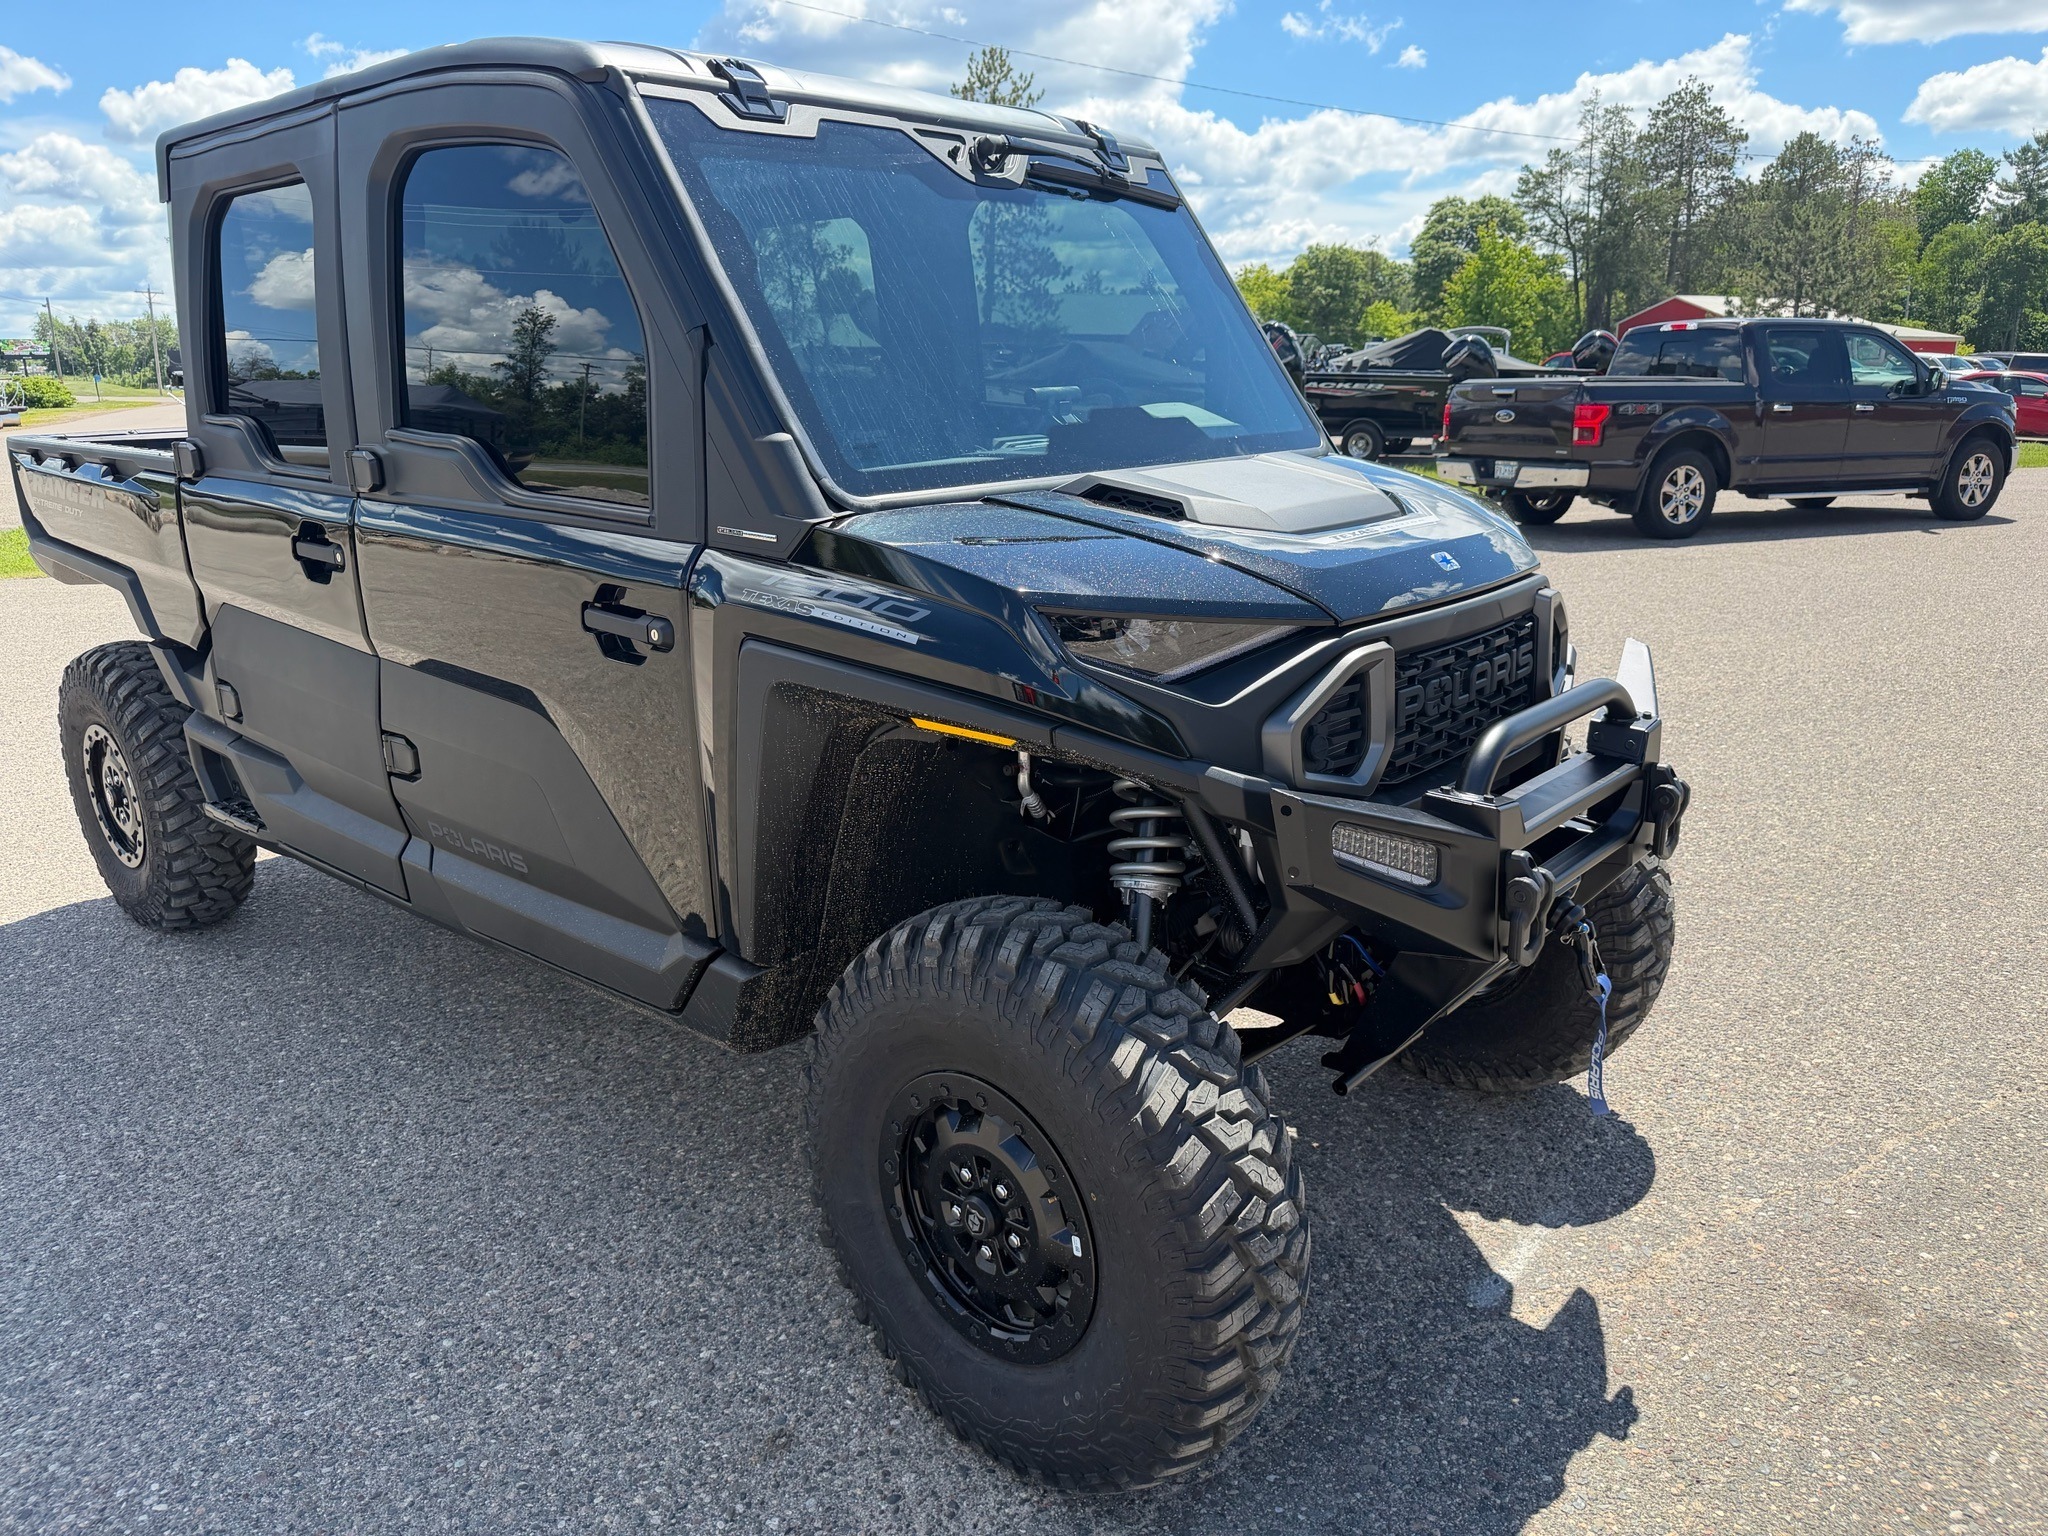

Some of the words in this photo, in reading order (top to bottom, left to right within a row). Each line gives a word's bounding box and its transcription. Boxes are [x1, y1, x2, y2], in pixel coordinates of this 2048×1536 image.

[30, 473, 106, 510] RANGER
[32, 496, 63, 512] EXTREME
[64, 505, 83, 517] DUTY
[740, 588, 816, 617] TEXAS
[820, 611, 907, 640] EDITION
[1397, 640, 1534, 732] POLARIS
[427, 820, 529, 874] POLARIS
[1590, 1029, 1605, 1101] POLARIS
